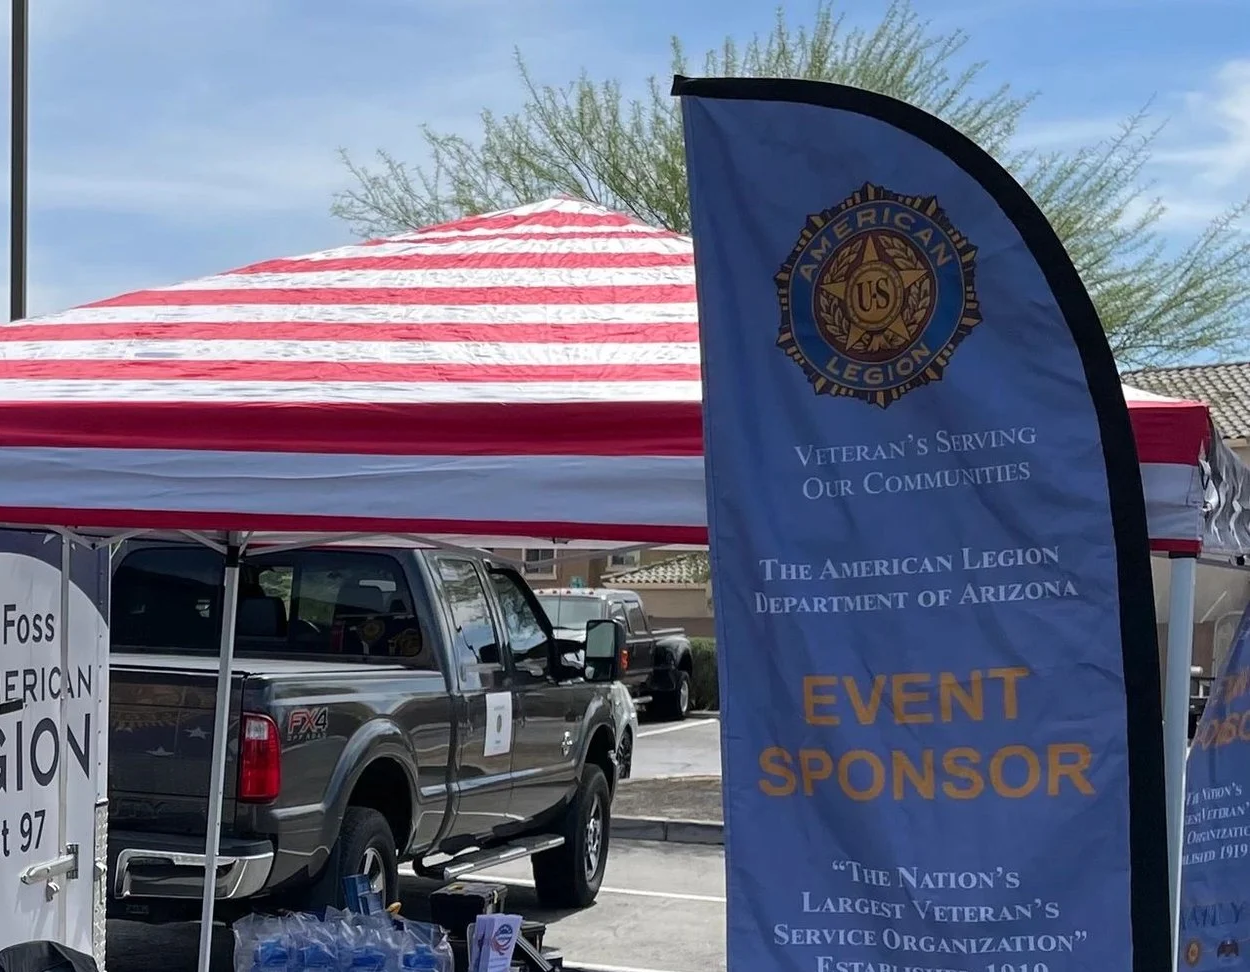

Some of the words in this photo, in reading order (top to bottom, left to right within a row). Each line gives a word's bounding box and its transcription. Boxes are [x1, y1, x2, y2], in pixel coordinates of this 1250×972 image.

[799, 206, 953, 284] AMERICAN
[826, 341, 931, 385] LEGION
[936, 426, 1037, 453] SERVING
[803, 476, 854, 500] OUR
[863, 461, 1031, 494] COMMUNITIES
[759, 558, 812, 581] THE
[819, 553, 953, 580] AMERICAN
[962, 545, 1060, 570] LEGION
[754, 591, 908, 614] DEPARTMENT
[917, 588, 952, 609] OF
[959, 579, 1079, 605] ARIZONA
[3, 604, 55, 645] Foss
[803, 667, 1030, 726] EVENT
[288, 706, 329, 734] FX4
[758, 742, 1096, 801] SPONSOR
[20, 809, 46, 852] 97
[1220, 843, 1249, 860] 1919
[898, 866, 1020, 889] NATION'S
[802, 892, 905, 920] LARGEST
[912, 898, 1060, 923] VETERAN'S
[773, 923, 876, 945] SERVICE
